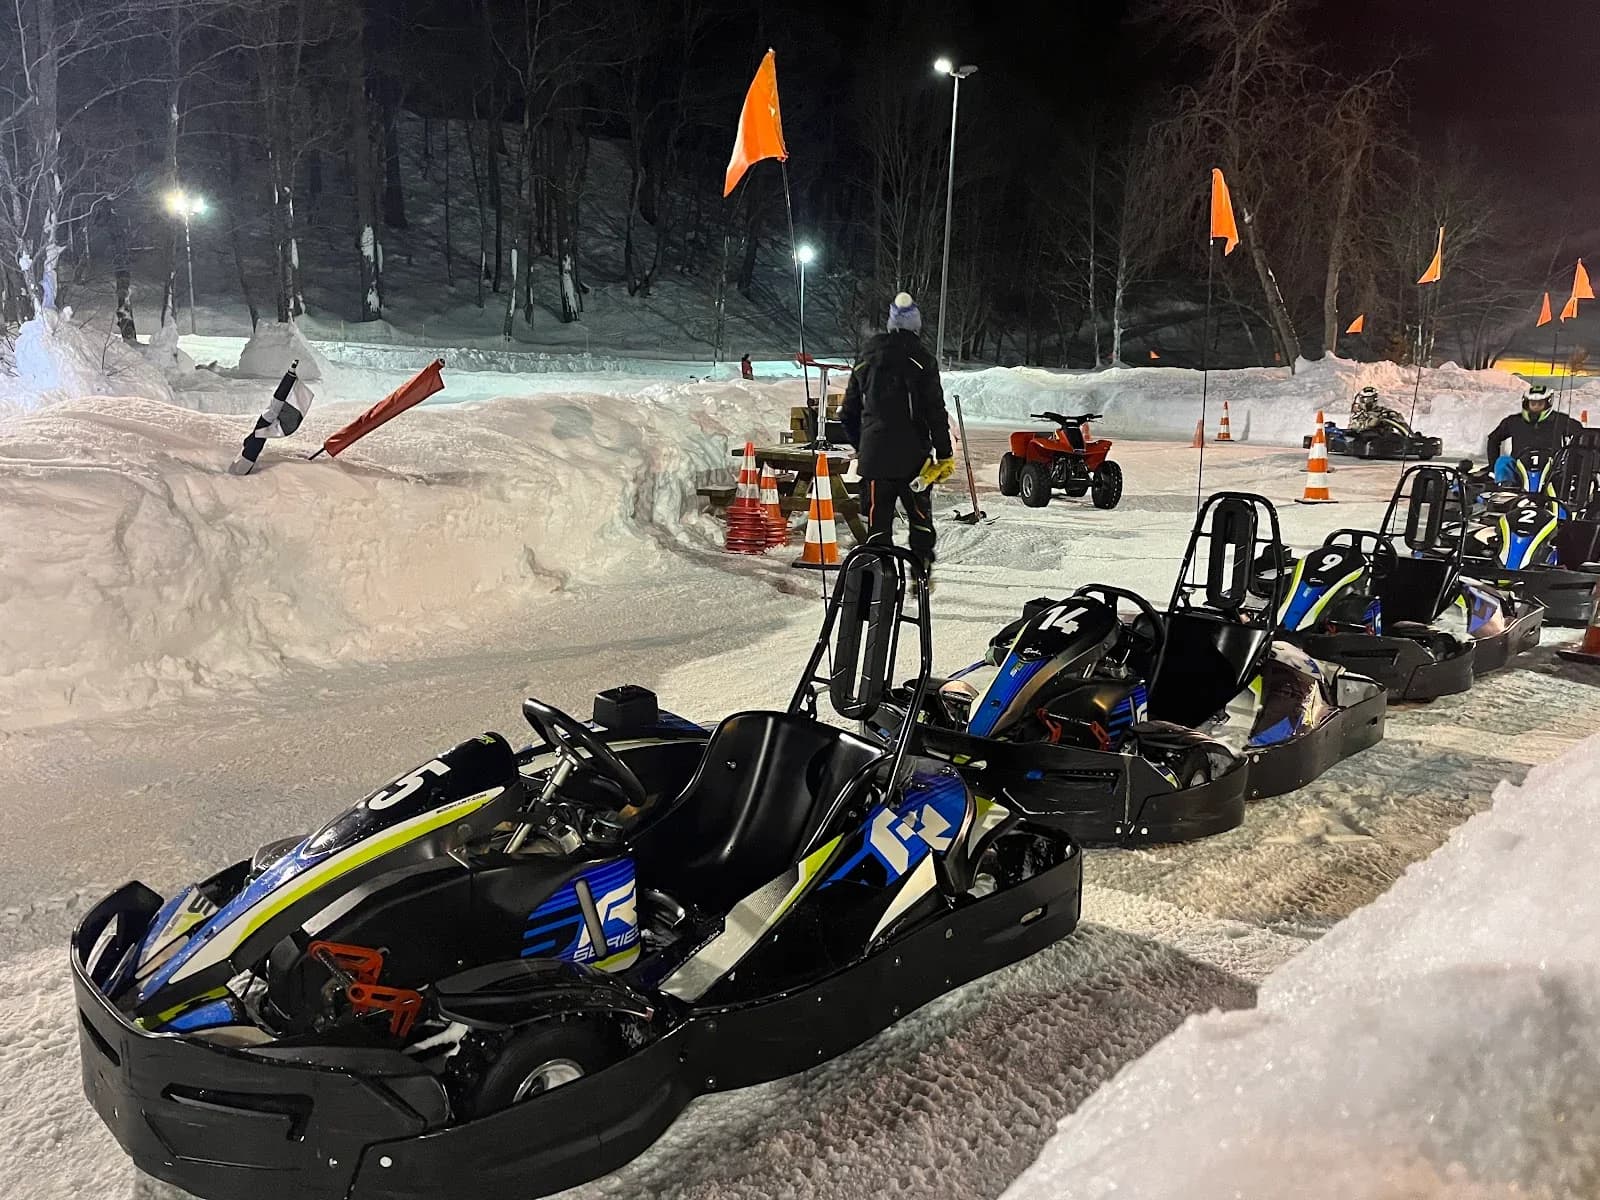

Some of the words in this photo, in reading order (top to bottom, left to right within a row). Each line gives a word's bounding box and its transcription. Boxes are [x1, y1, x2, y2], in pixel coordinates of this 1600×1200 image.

[1530, 455, 1540, 466] 1
[1517, 509, 1538, 524] 2
[1317, 553, 1344, 572] 9
[1037, 605, 1090, 635] 14
[367, 758, 452, 811] 5
[572, 924, 640, 962] SRIE
